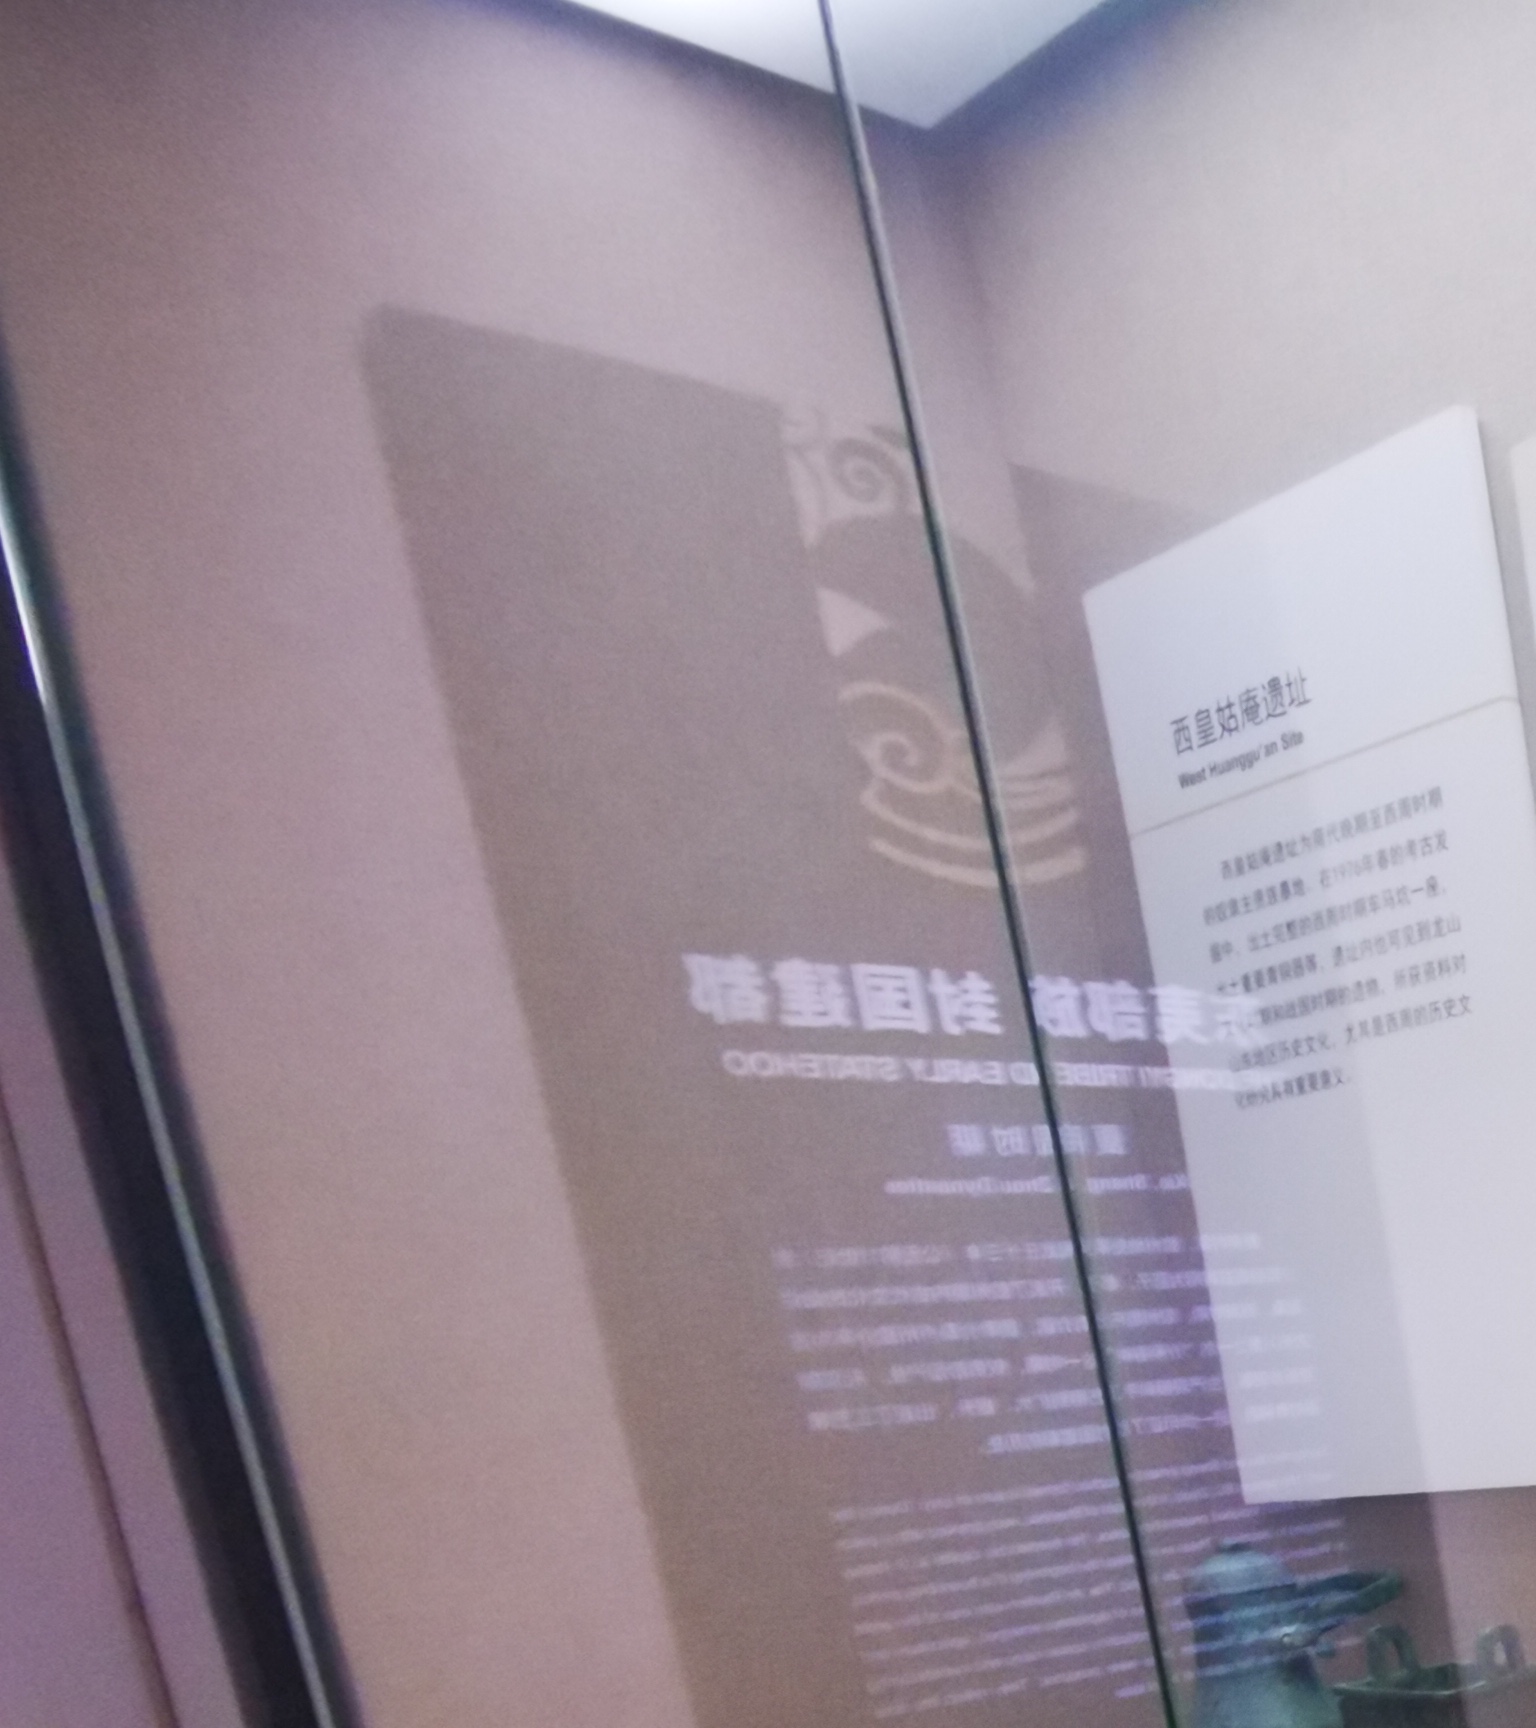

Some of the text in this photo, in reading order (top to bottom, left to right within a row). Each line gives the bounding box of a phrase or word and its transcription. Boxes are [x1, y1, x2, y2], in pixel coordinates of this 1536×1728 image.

[1169, 666, 1312, 756] 西皇姑庵遗址
